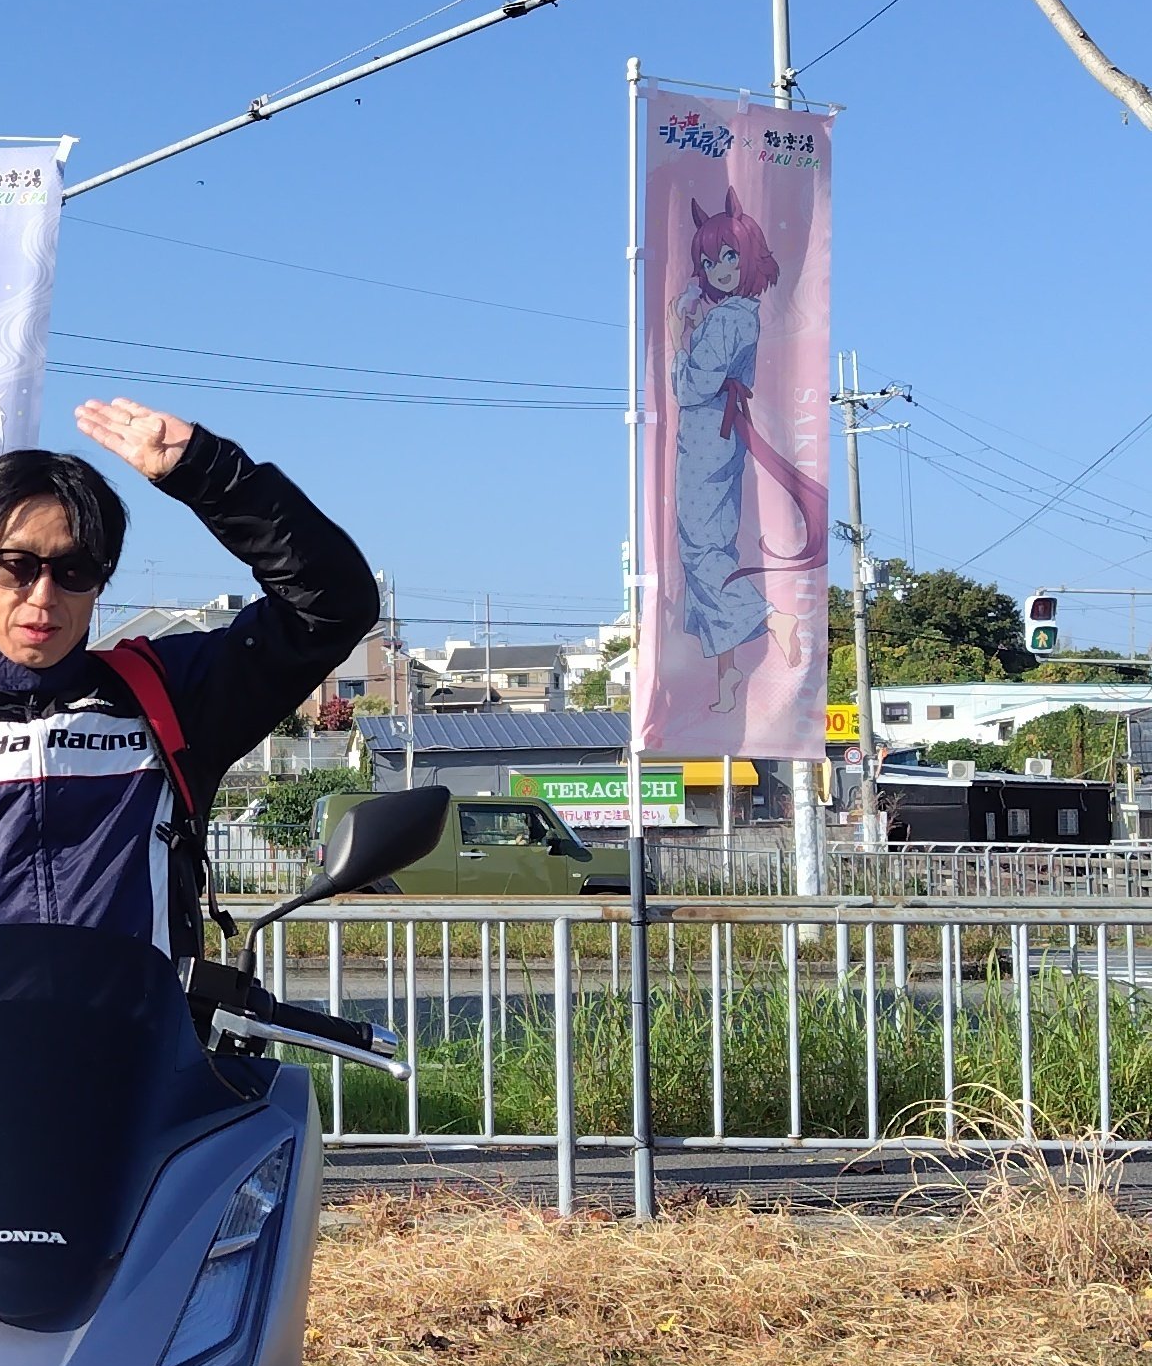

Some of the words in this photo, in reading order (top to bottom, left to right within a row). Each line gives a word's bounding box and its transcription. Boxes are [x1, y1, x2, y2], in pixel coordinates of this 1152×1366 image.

[758, 150, 792, 166] RAKU
[796, 156, 820, 170] SPA
[20, 192, 47, 204] SPA
[47, 728, 148, 751] Racing
